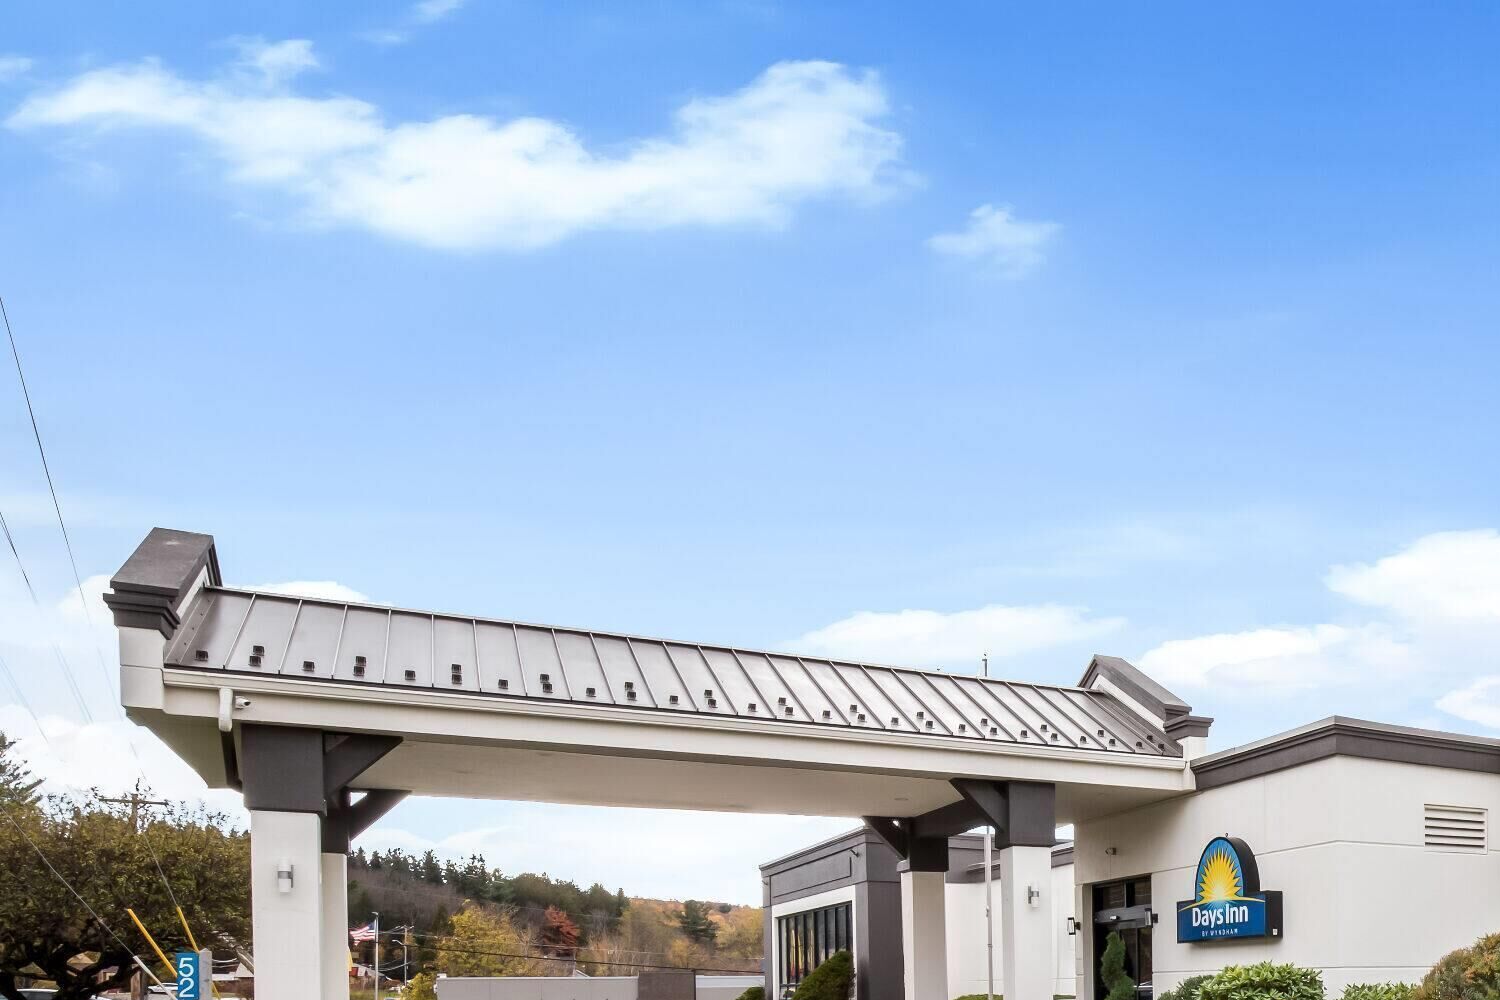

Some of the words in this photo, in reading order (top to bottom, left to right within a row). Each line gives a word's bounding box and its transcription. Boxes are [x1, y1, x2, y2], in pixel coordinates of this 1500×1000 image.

[1192, 907, 1224, 929] Days
[1225, 903, 1249, 924] Inn
[1210, 928, 1239, 937] WYNDHAM
